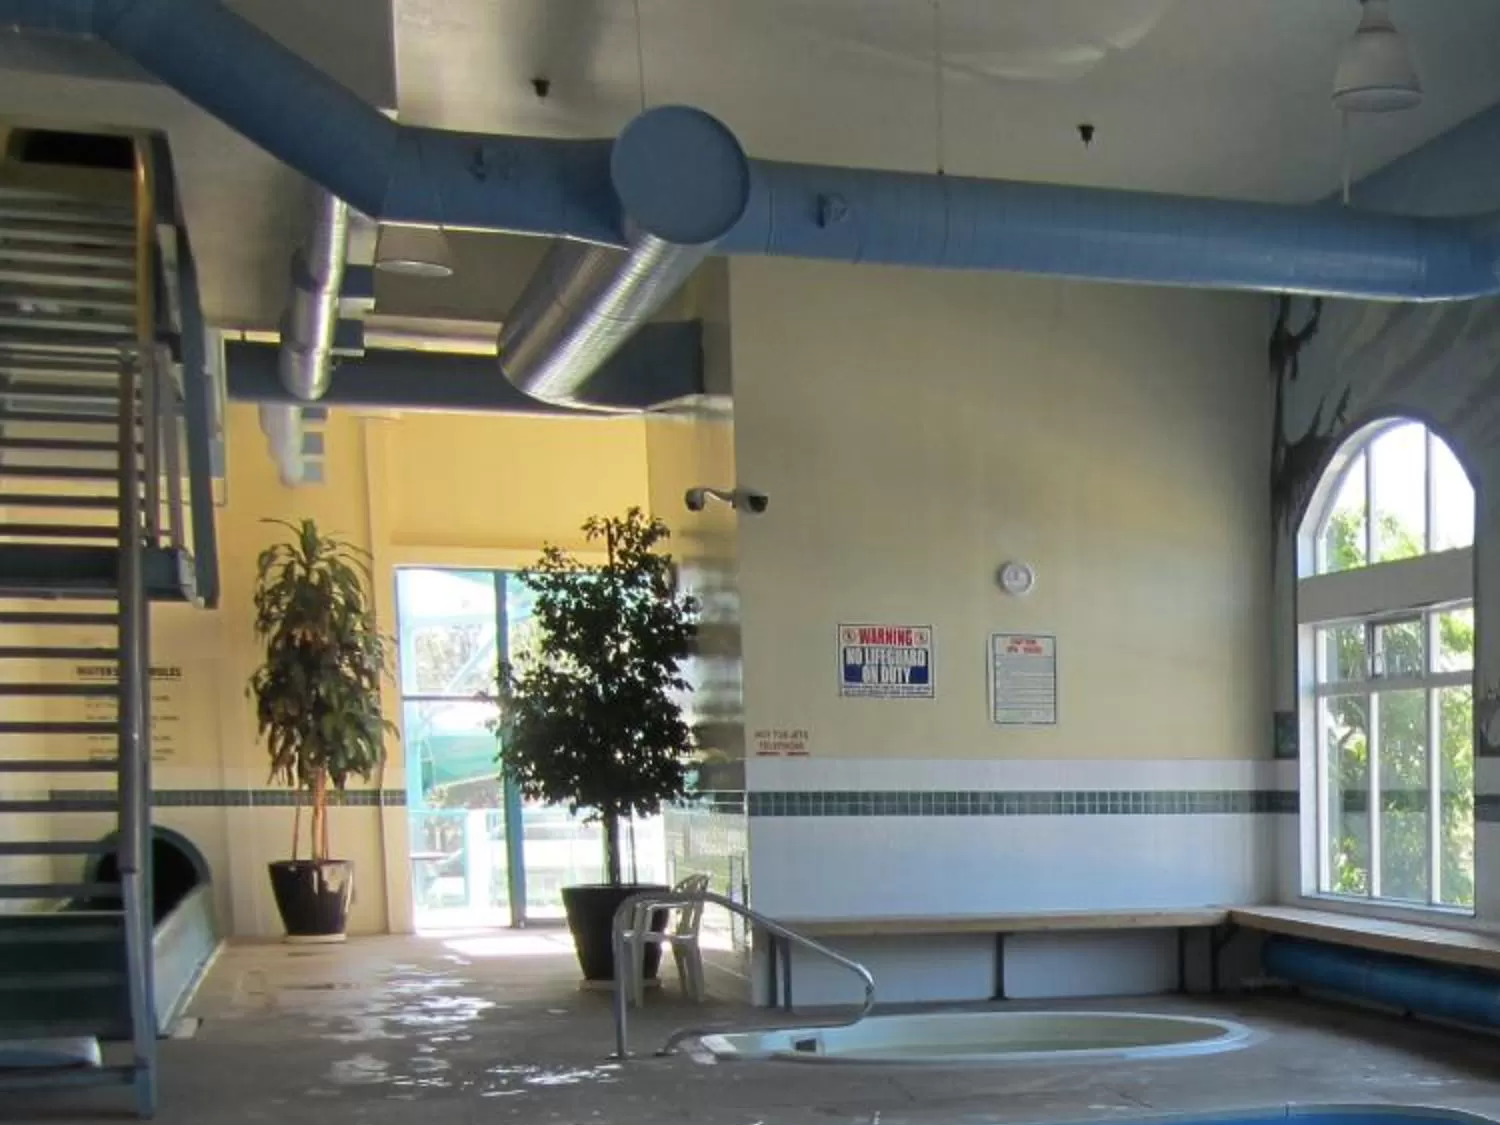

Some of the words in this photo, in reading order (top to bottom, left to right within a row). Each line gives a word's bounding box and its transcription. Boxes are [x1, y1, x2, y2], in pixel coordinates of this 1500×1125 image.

[860, 627, 913, 646] WARNING
[845, 648, 862, 665] NO
[865, 648, 926, 666] LIFEGUARD
[862, 665, 878, 683] ON
[881, 666, 911, 684] DUTY
